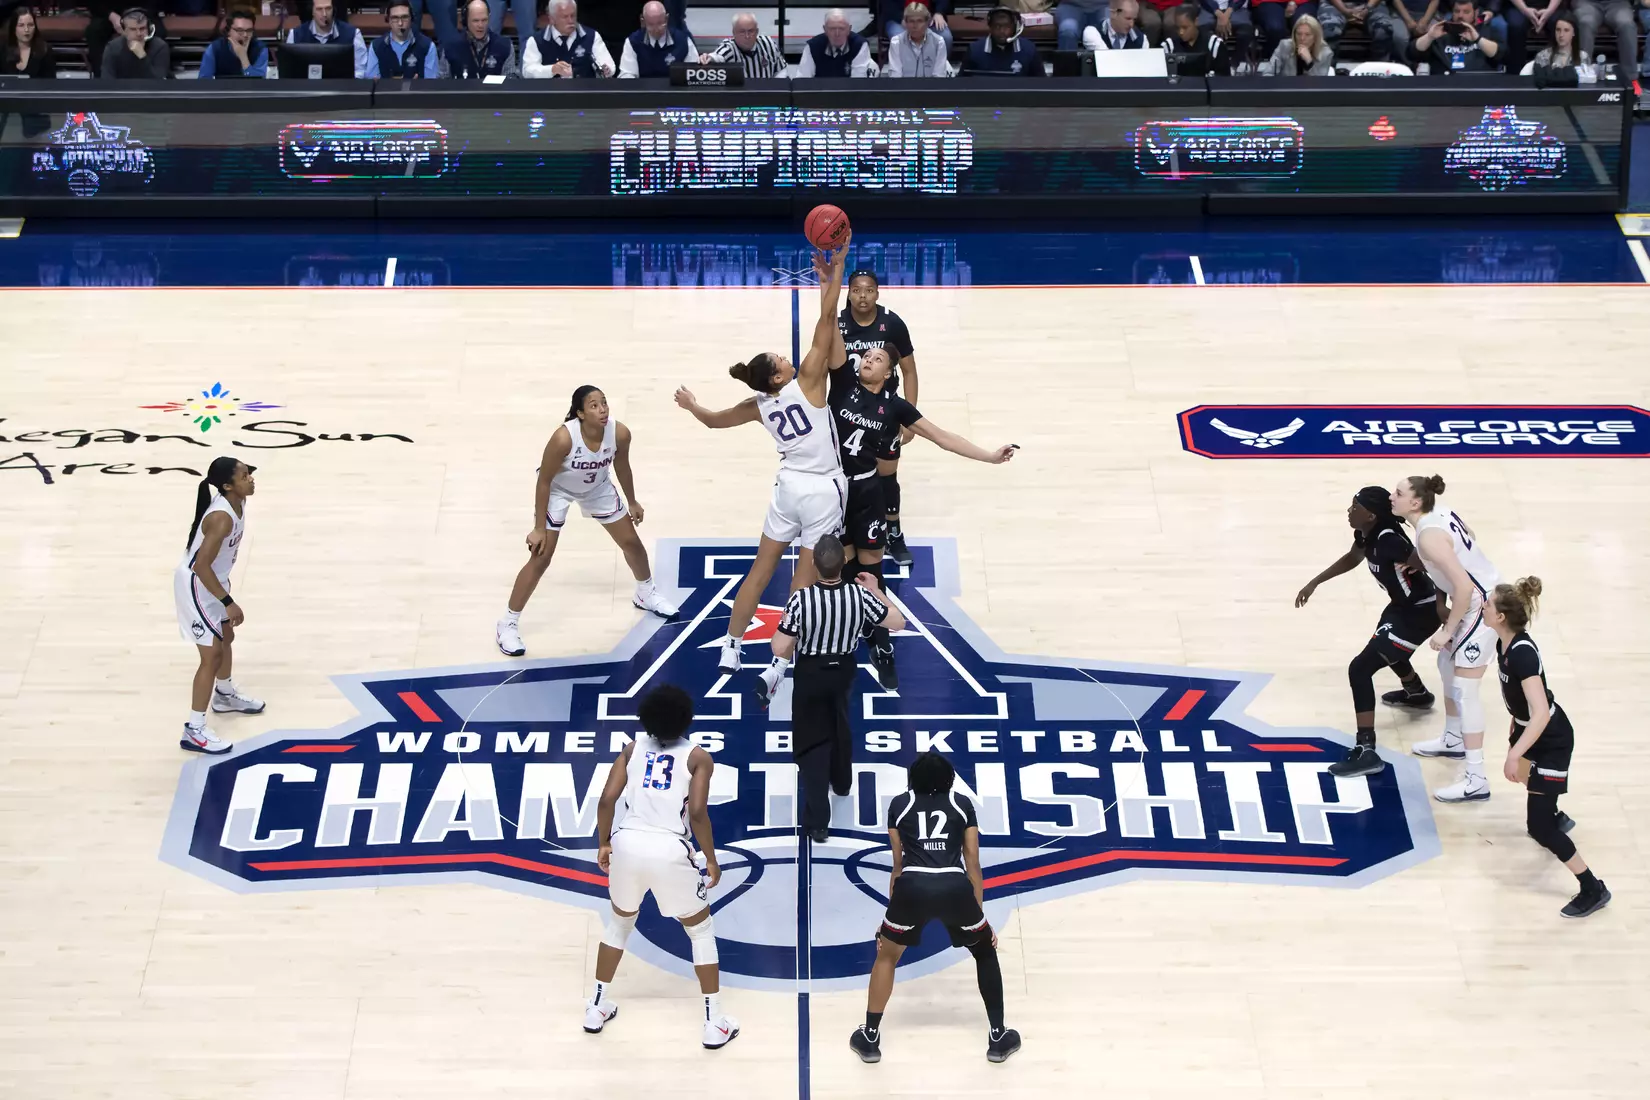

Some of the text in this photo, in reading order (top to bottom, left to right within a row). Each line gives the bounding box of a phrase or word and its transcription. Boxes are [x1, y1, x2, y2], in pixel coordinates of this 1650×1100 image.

[686, 69, 727, 81] POSS
[1598, 93, 1621, 102] ANC
[774, 111, 924, 125] BASKETBALL
[610, 130, 974, 194] CHAMPIONSHIP
[844, 340, 886, 350] INCINNATI
[768, 403, 813, 442] 20
[839, 408, 883, 431] CINCINNATI
[1321, 419, 1636, 433] AIR FORCE
[232, 420, 414, 449] Sun
[842, 428, 865, 457] 4
[1343, 432, 1621, 446] RESERVE
[0, 452, 203, 485] Aren
[571, 456, 613, 470] UCONN
[583, 472, 598, 484] 3
[376, 730, 1232, 754] WOMENS BSKETBALL
[644, 751, 676, 791] 13
[916, 810, 950, 841] 12
[923, 841, 946, 851] MILLER
